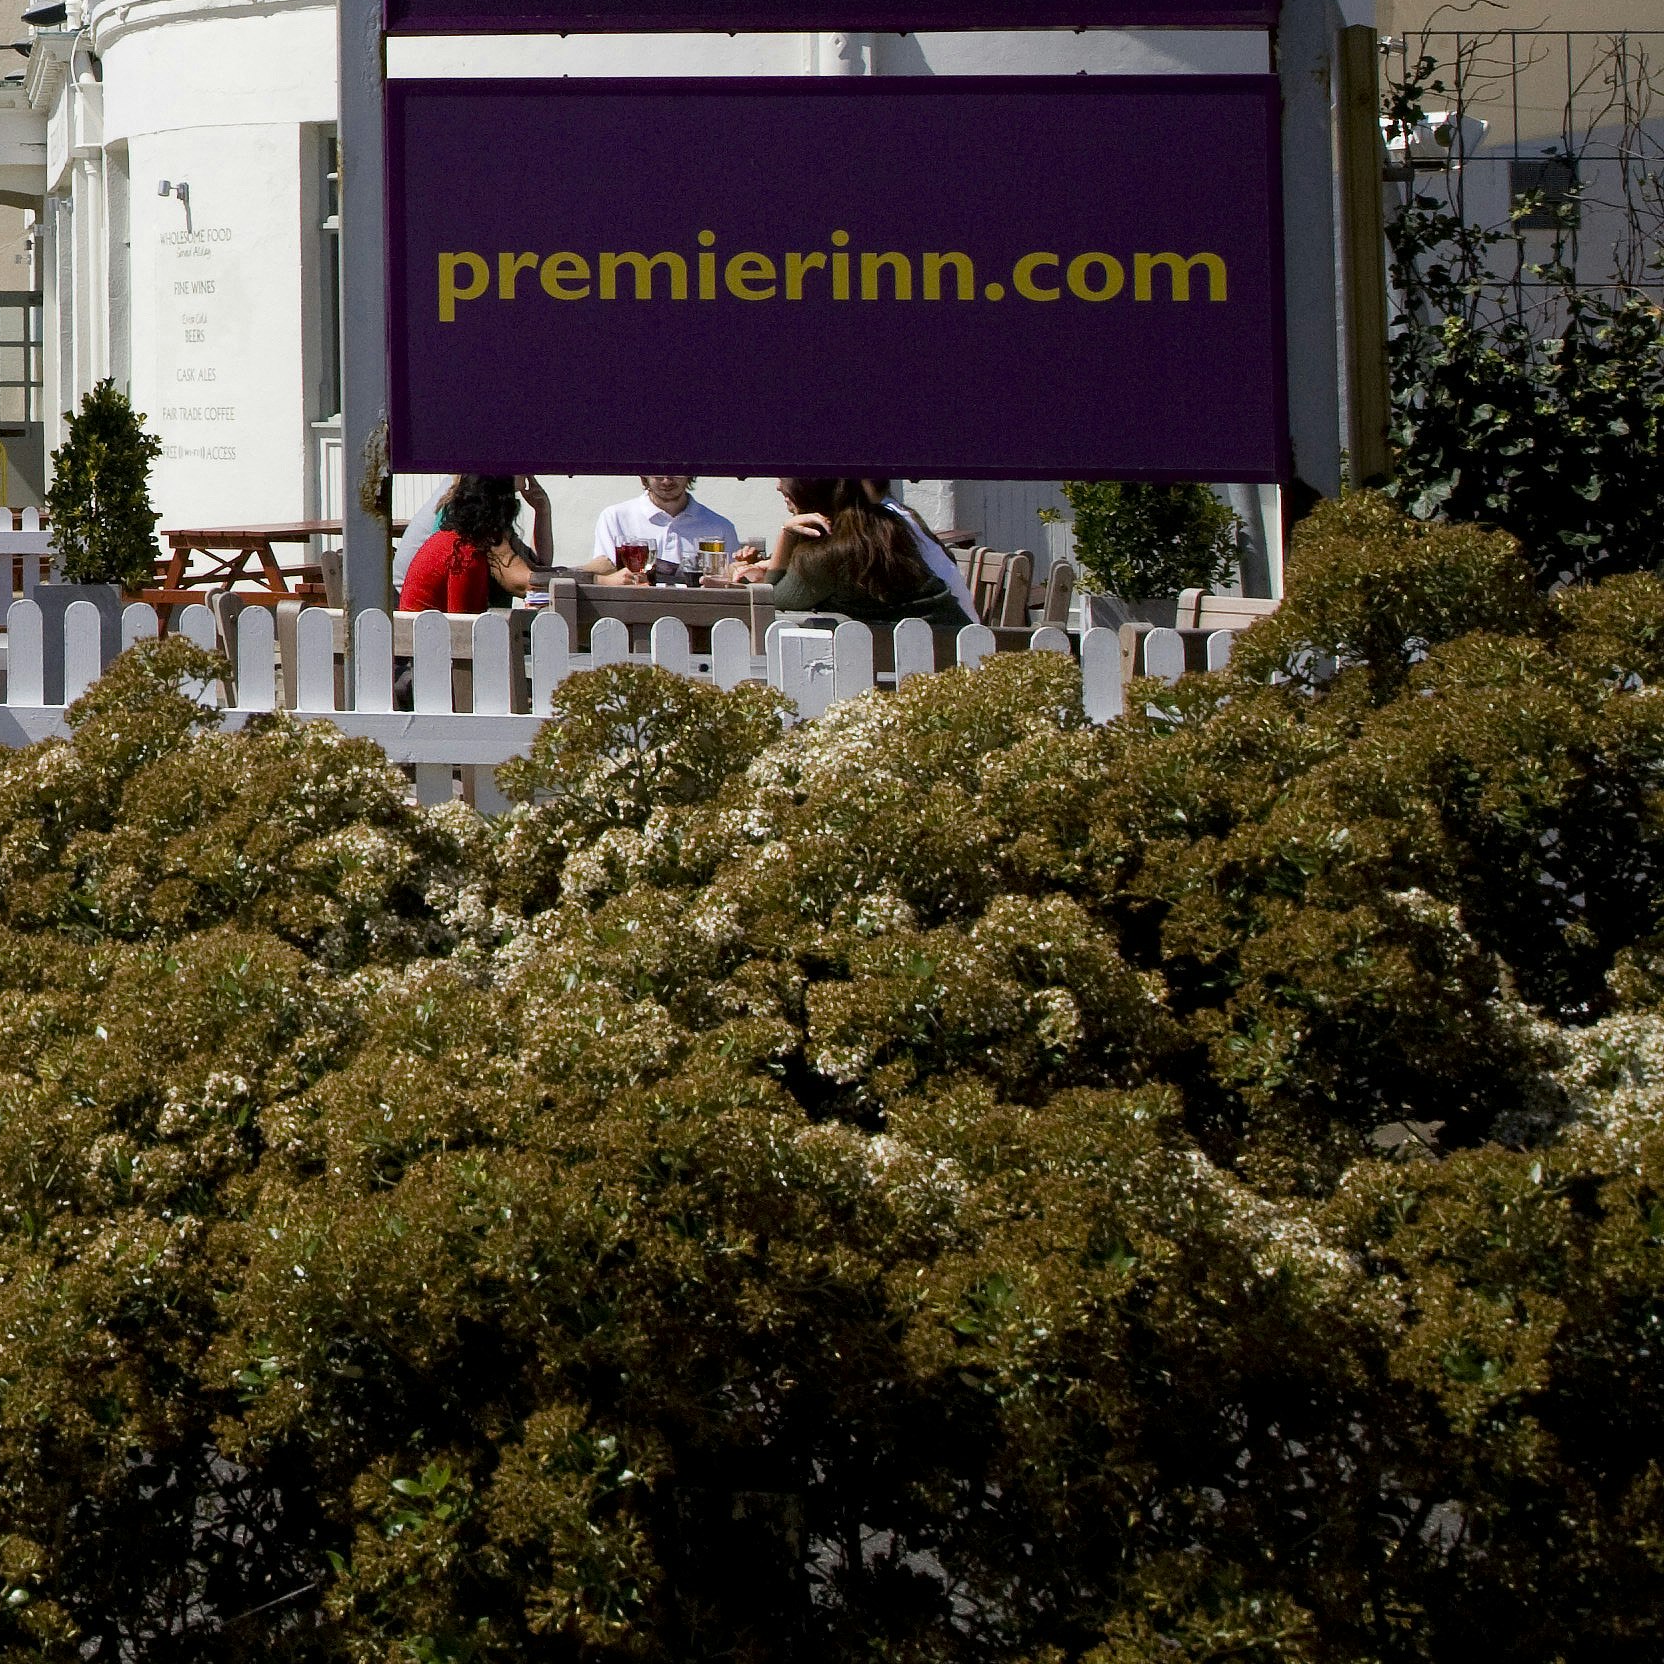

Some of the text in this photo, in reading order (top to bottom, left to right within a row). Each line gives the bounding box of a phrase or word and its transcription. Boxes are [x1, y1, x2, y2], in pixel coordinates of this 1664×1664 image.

[160, 228, 231, 245] WHOLESOME FOOD
[438, 229, 1228, 322] premierinn.com
[174, 280, 216, 295] FINE WINES
[184, 329, 205, 343] BEERS
[176, 368, 217, 382] CASK ALES
[162, 407, 236, 421] FAIR TRADE COFFEE
[206, 446, 237, 460] ACCESS
